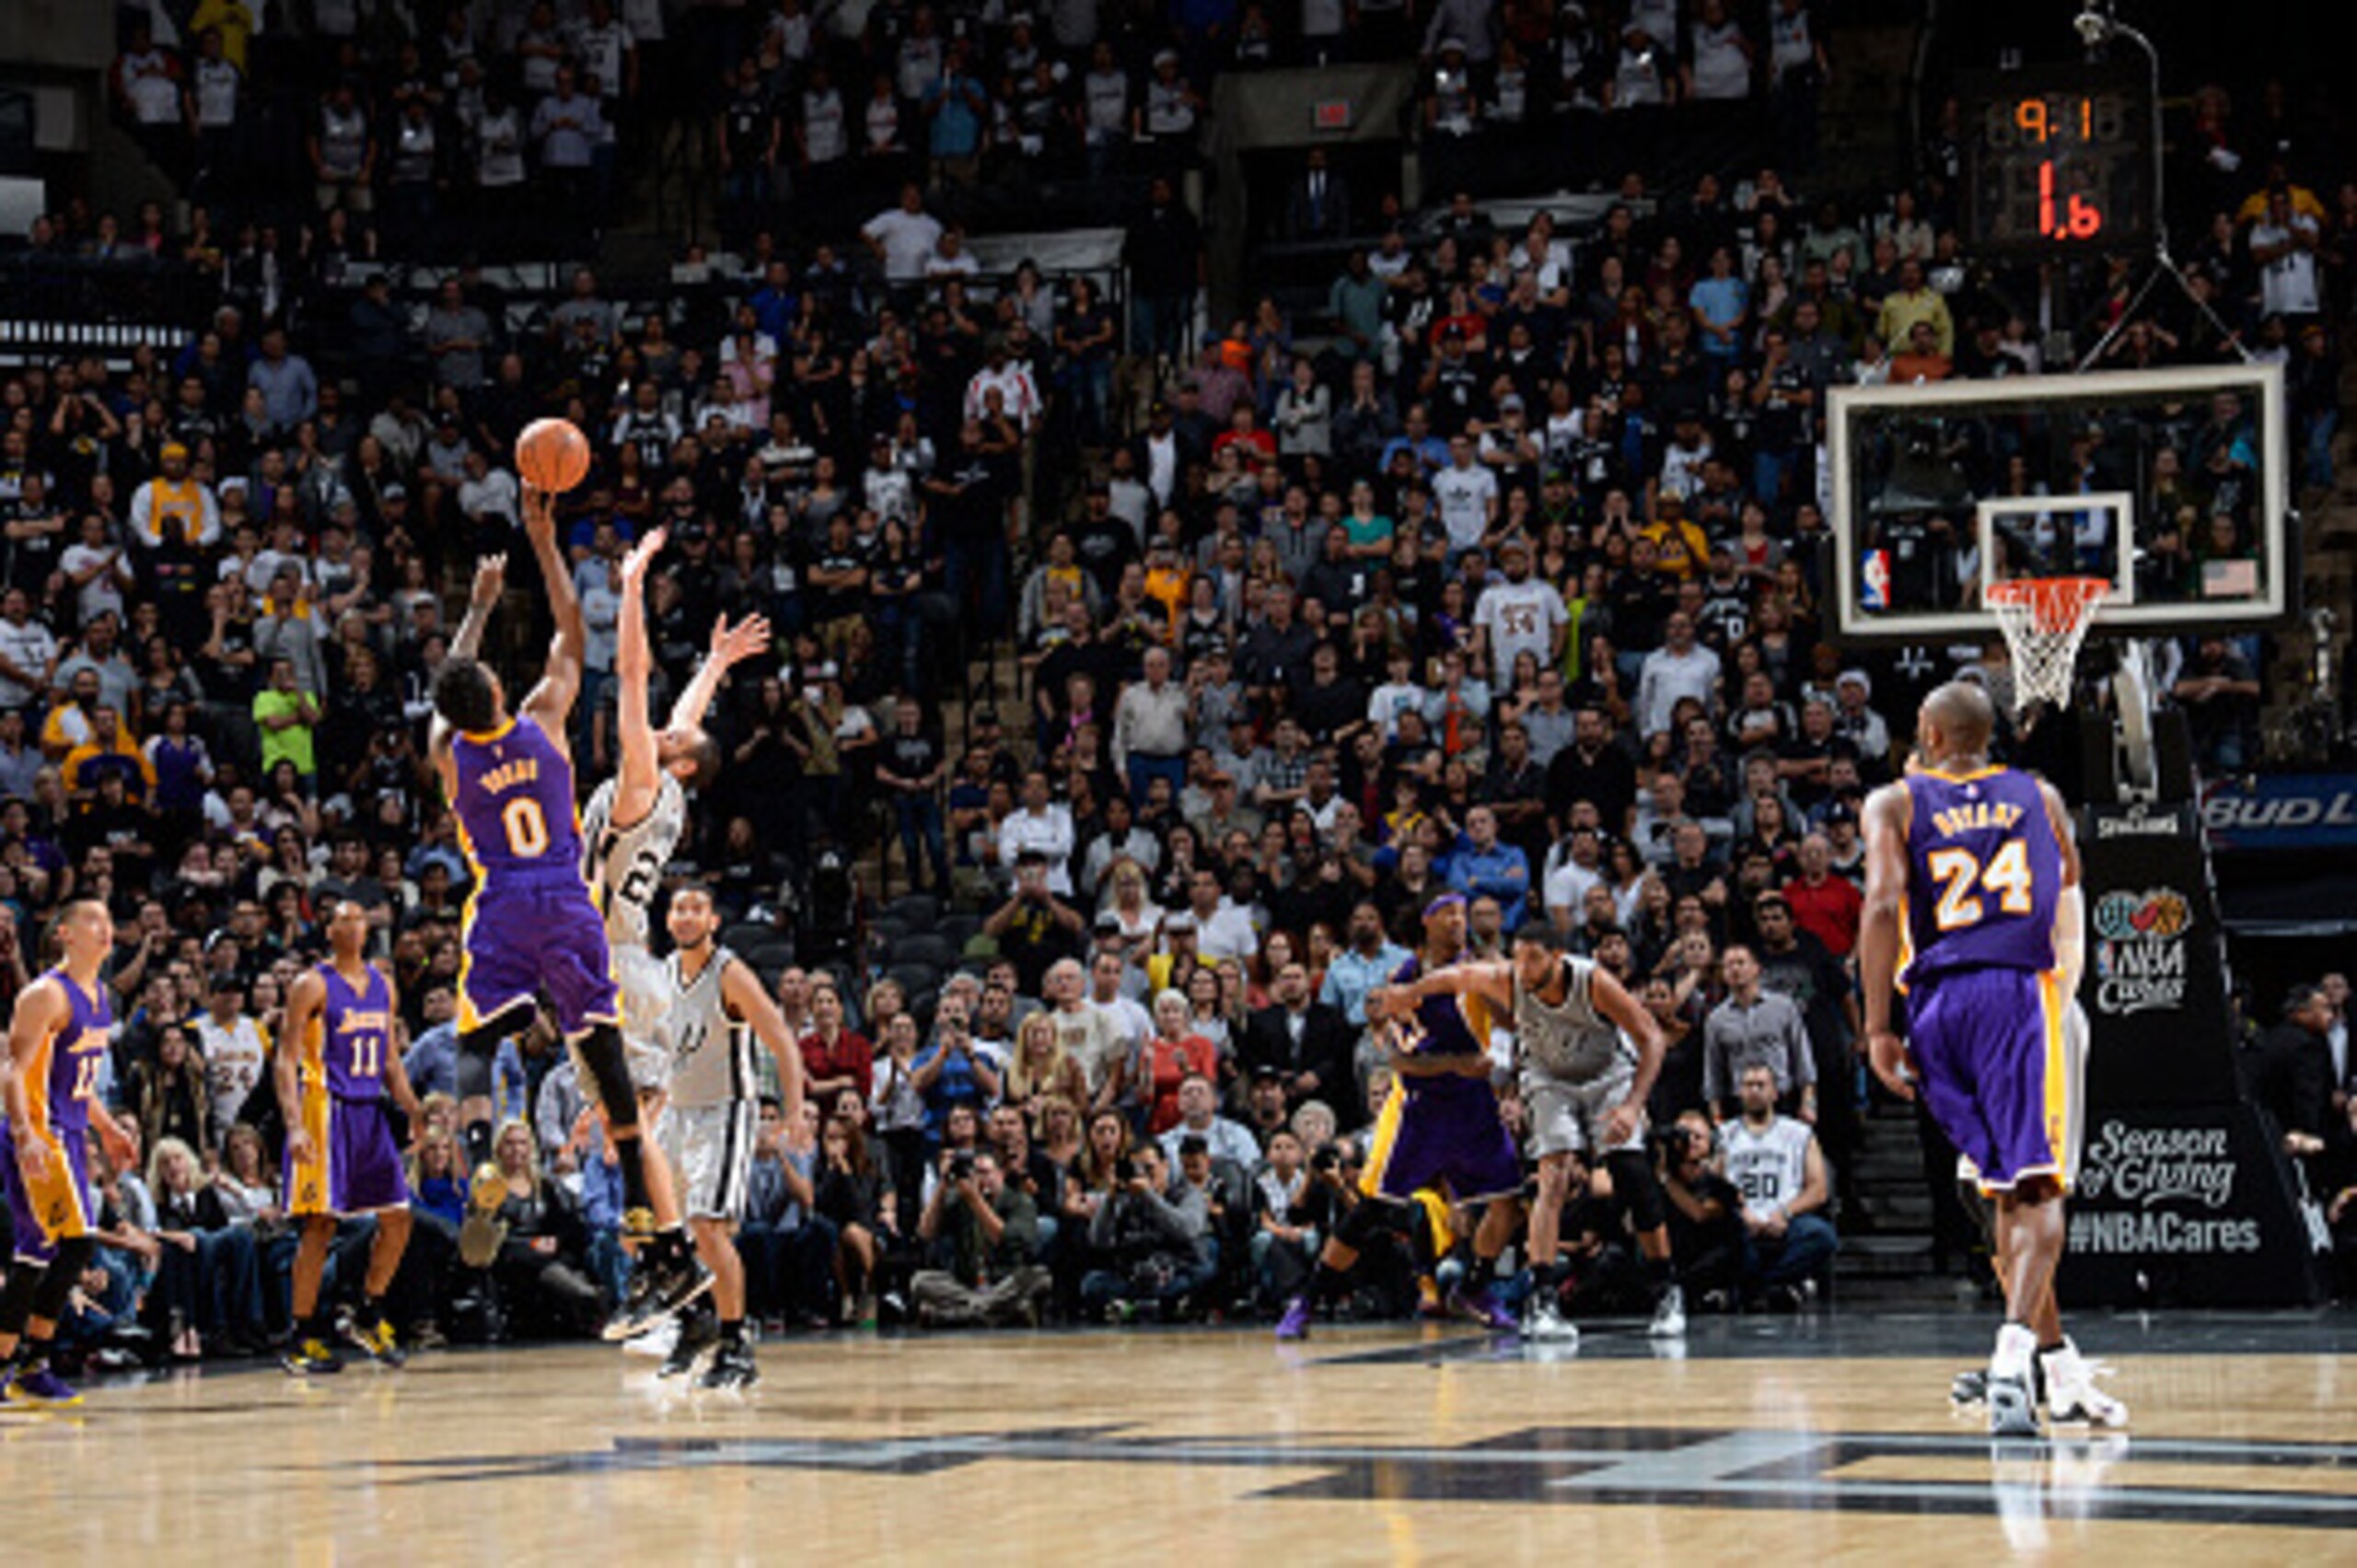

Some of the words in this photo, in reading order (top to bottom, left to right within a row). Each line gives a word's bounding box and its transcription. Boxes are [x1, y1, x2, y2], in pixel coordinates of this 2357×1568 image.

[501, 796, 551, 858] 0
[1932, 801, 2024, 839] BRYANT
[2206, 797, 2321, 829] BUD
[1927, 837, 2032, 932] 24
[351, 1037, 380, 1077] 11
[2092, 1119, 2227, 1159] Season
[1742, 1173, 1780, 1199] 20
[2113, 1156, 2236, 1208] Giving
[2069, 1212, 2260, 1253] #NBACares
